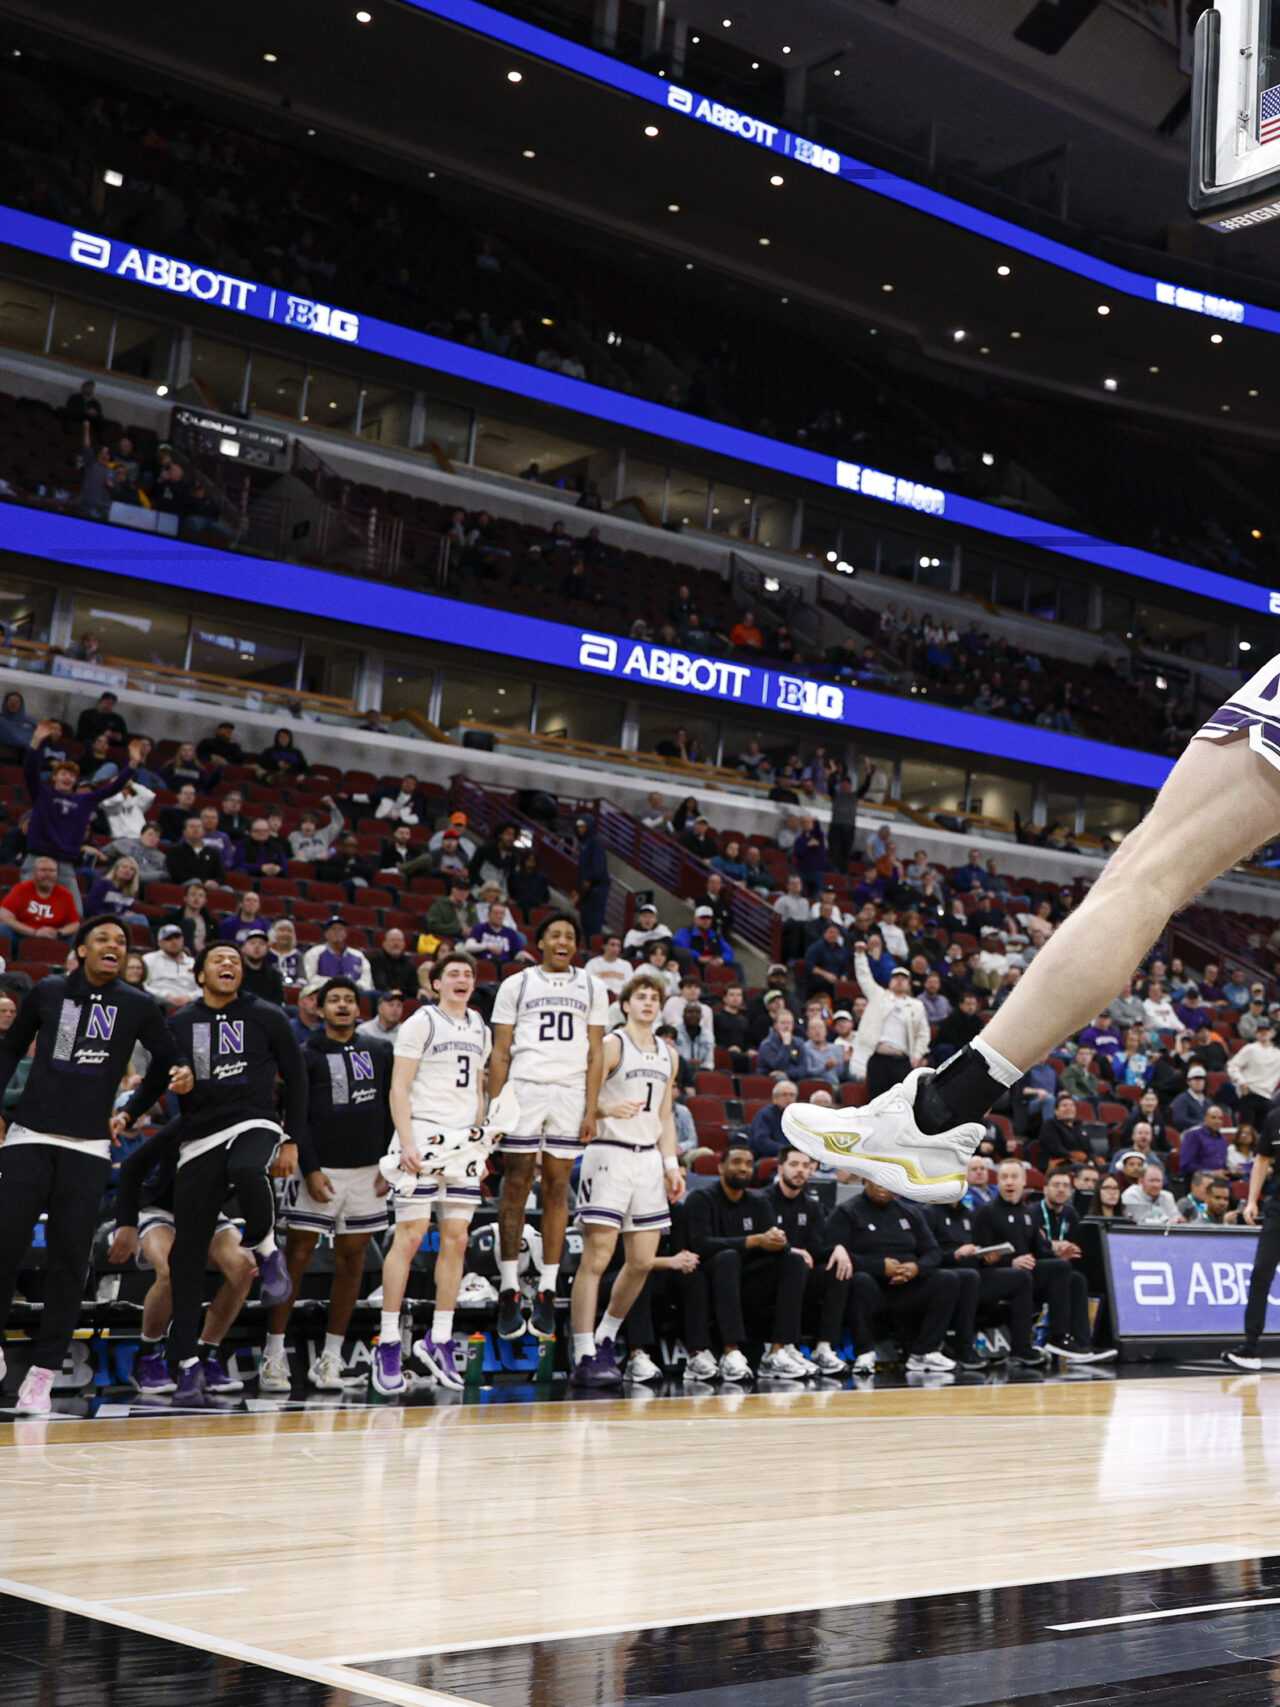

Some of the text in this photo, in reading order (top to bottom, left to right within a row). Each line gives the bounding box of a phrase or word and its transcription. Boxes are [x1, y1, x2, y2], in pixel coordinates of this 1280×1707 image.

[695, 98, 778, 148] ABBOTT
[116, 248, 257, 311] ABBOTT
[622, 645, 751, 698] ABBOTT
[27, 899, 54, 919] STL
[85, 1003, 118, 1041] N
[218, 1020, 245, 1055] N
[538, 1011, 574, 1042] 20
[349, 1050, 375, 1081] N
[456, 1055, 470, 1088] 3
[642, 1082, 653, 1113] 1
